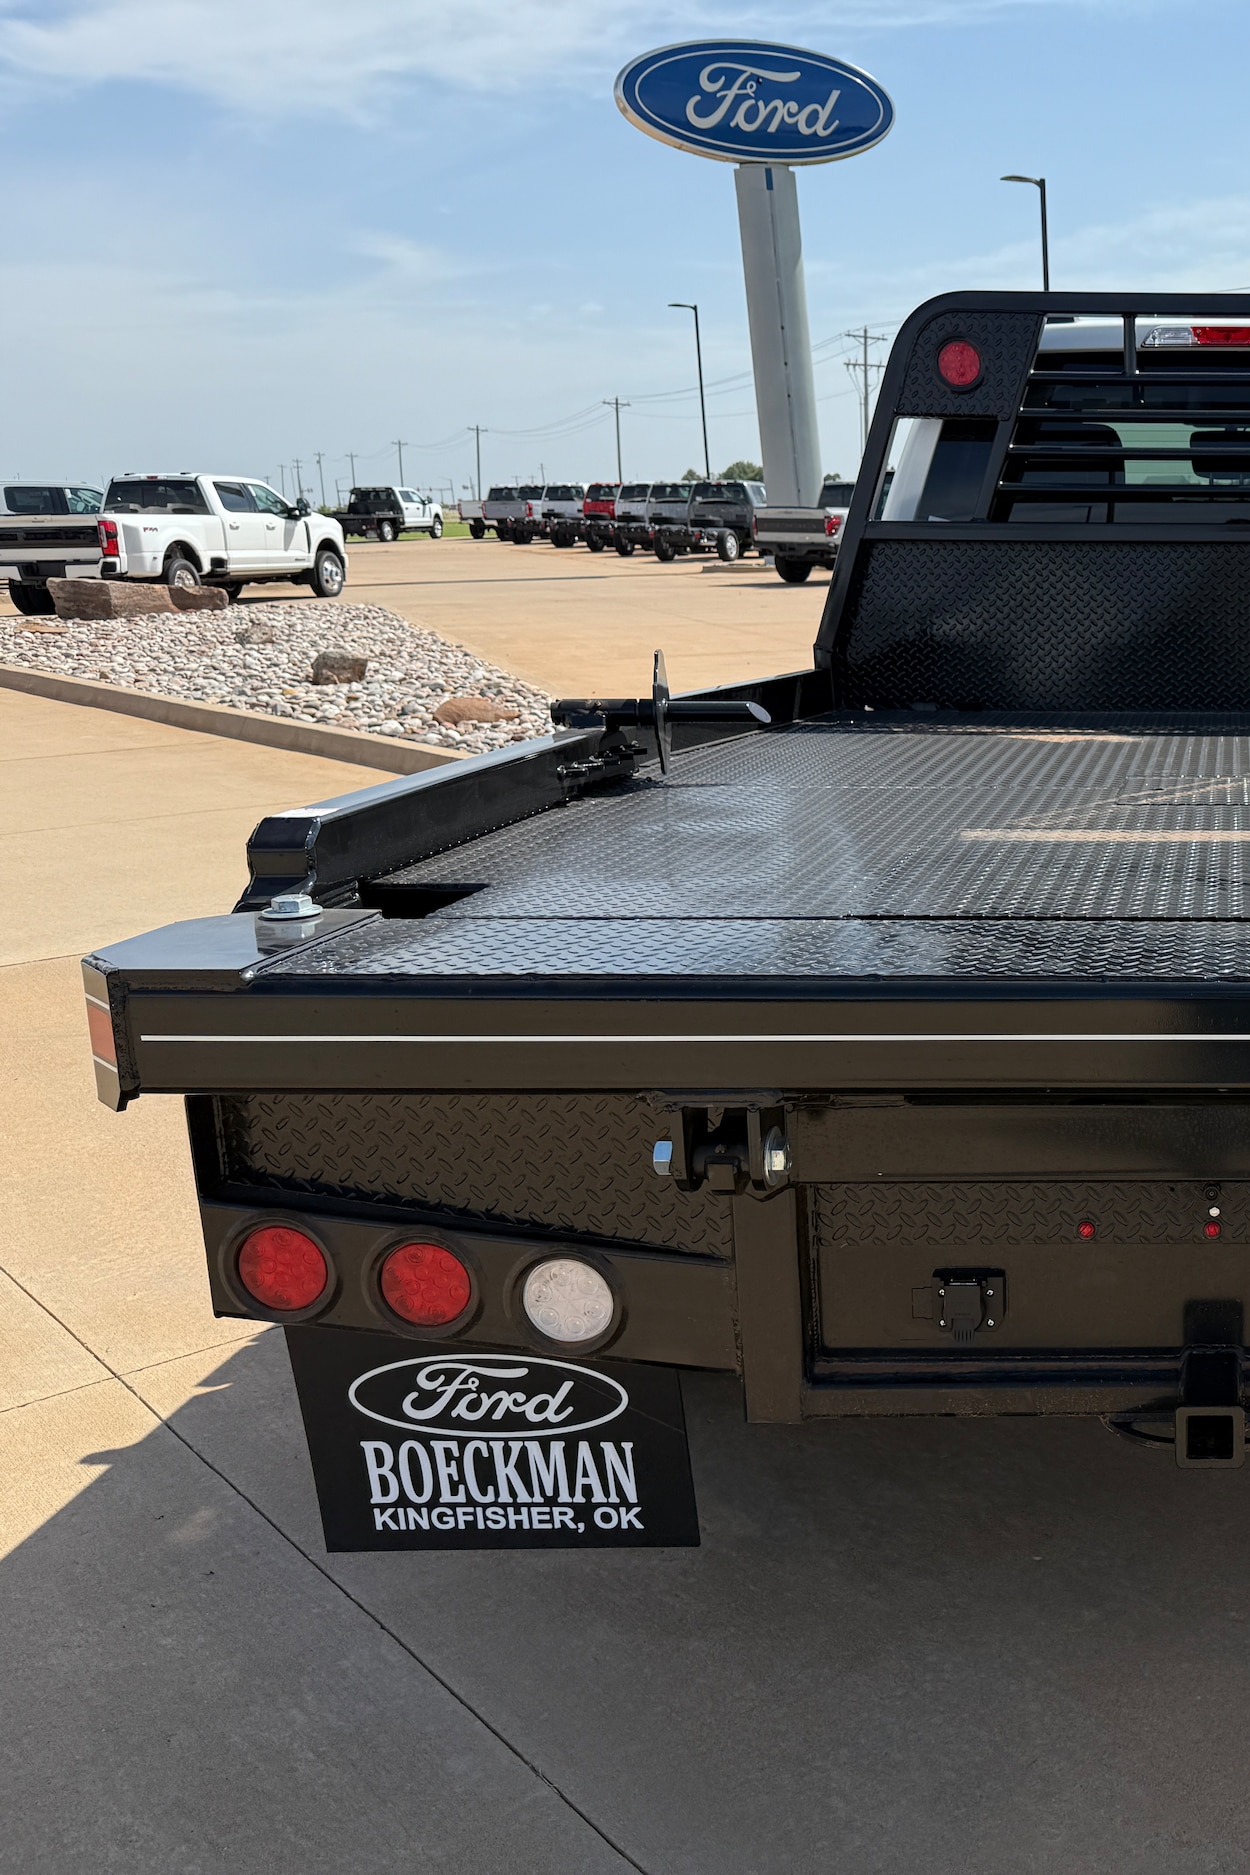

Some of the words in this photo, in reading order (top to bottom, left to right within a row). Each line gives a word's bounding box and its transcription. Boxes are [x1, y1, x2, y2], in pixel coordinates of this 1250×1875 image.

[686, 62, 841, 137] Ford
[402, 1362, 576, 1423] Ford
[360, 1440, 639, 1504] BOECKMAN
[373, 1506, 585, 1534] KINGFISHER,
[593, 1506, 646, 1530] OK
